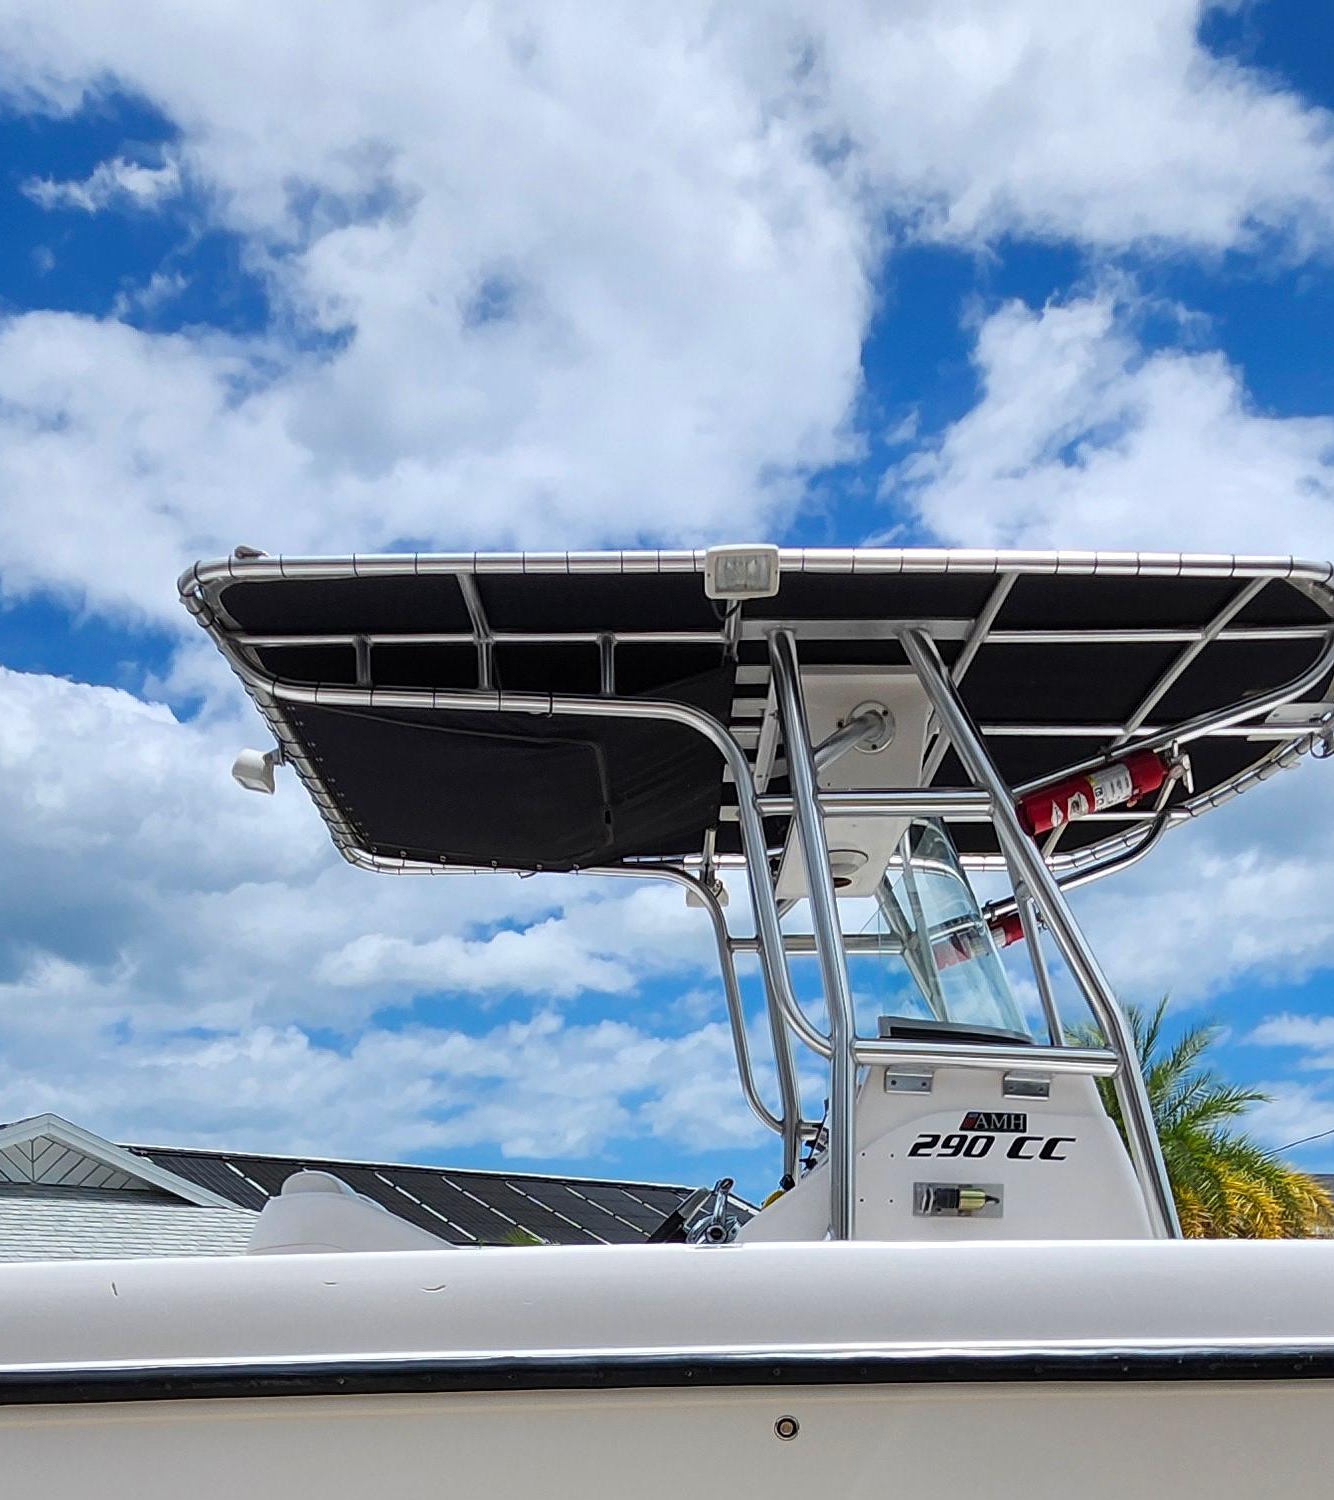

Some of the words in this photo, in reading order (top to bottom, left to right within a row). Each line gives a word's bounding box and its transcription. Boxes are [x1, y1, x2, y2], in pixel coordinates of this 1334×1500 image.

[973, 1113, 1026, 1131] AMH
[907, 1134, 995, 1158] 290
[1007, 1136, 1077, 1161] CC
